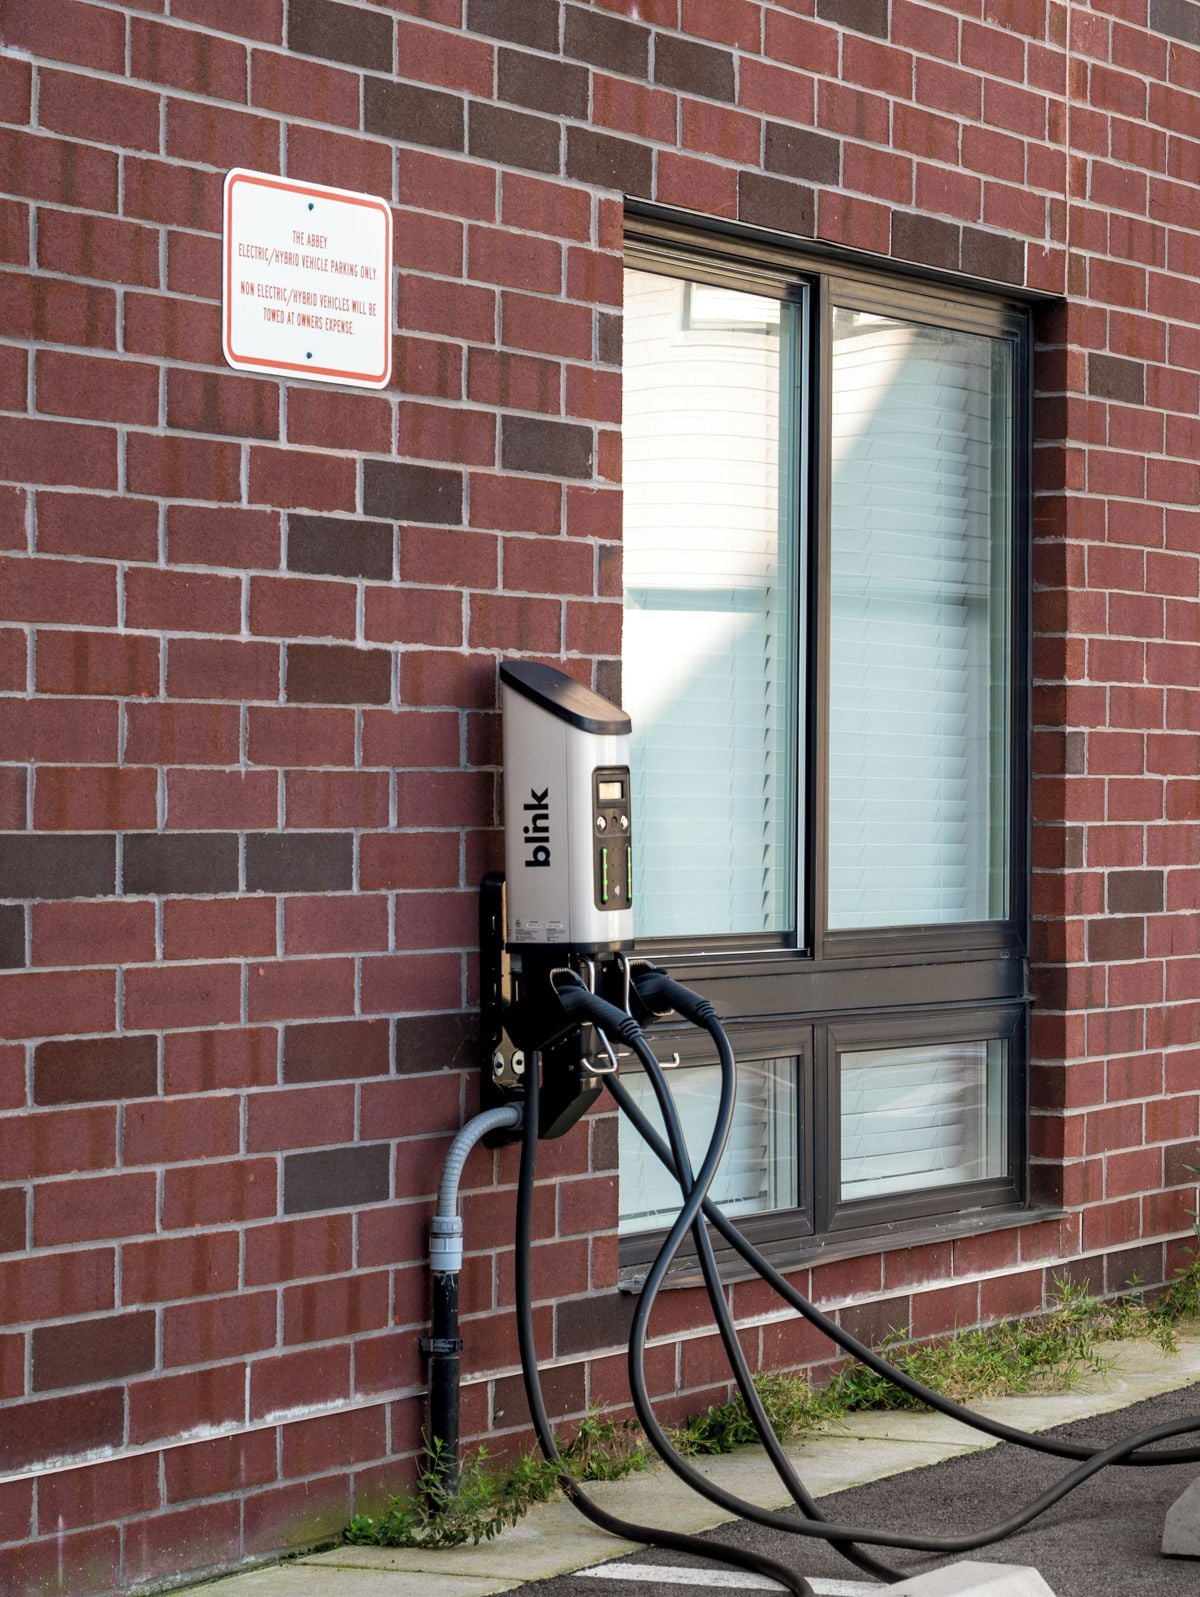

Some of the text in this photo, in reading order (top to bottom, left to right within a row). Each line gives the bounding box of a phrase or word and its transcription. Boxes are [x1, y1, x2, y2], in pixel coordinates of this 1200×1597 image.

[293, 230, 328, 249] THE ABBEY
[238, 243, 299, 267] ELECTRIC/HYBRID
[302, 255, 328, 272] VEHICLE
[330, 260, 358, 277] PARKING
[240, 281, 377, 317] NON ELECTRIC/HYBRID VEHICLES WILL BE
[263, 307, 285, 325] TOWED
[287, 312, 296, 325] AT
[297, 313, 324, 331] OWNERS
[523, 787, 551, 867] blink
